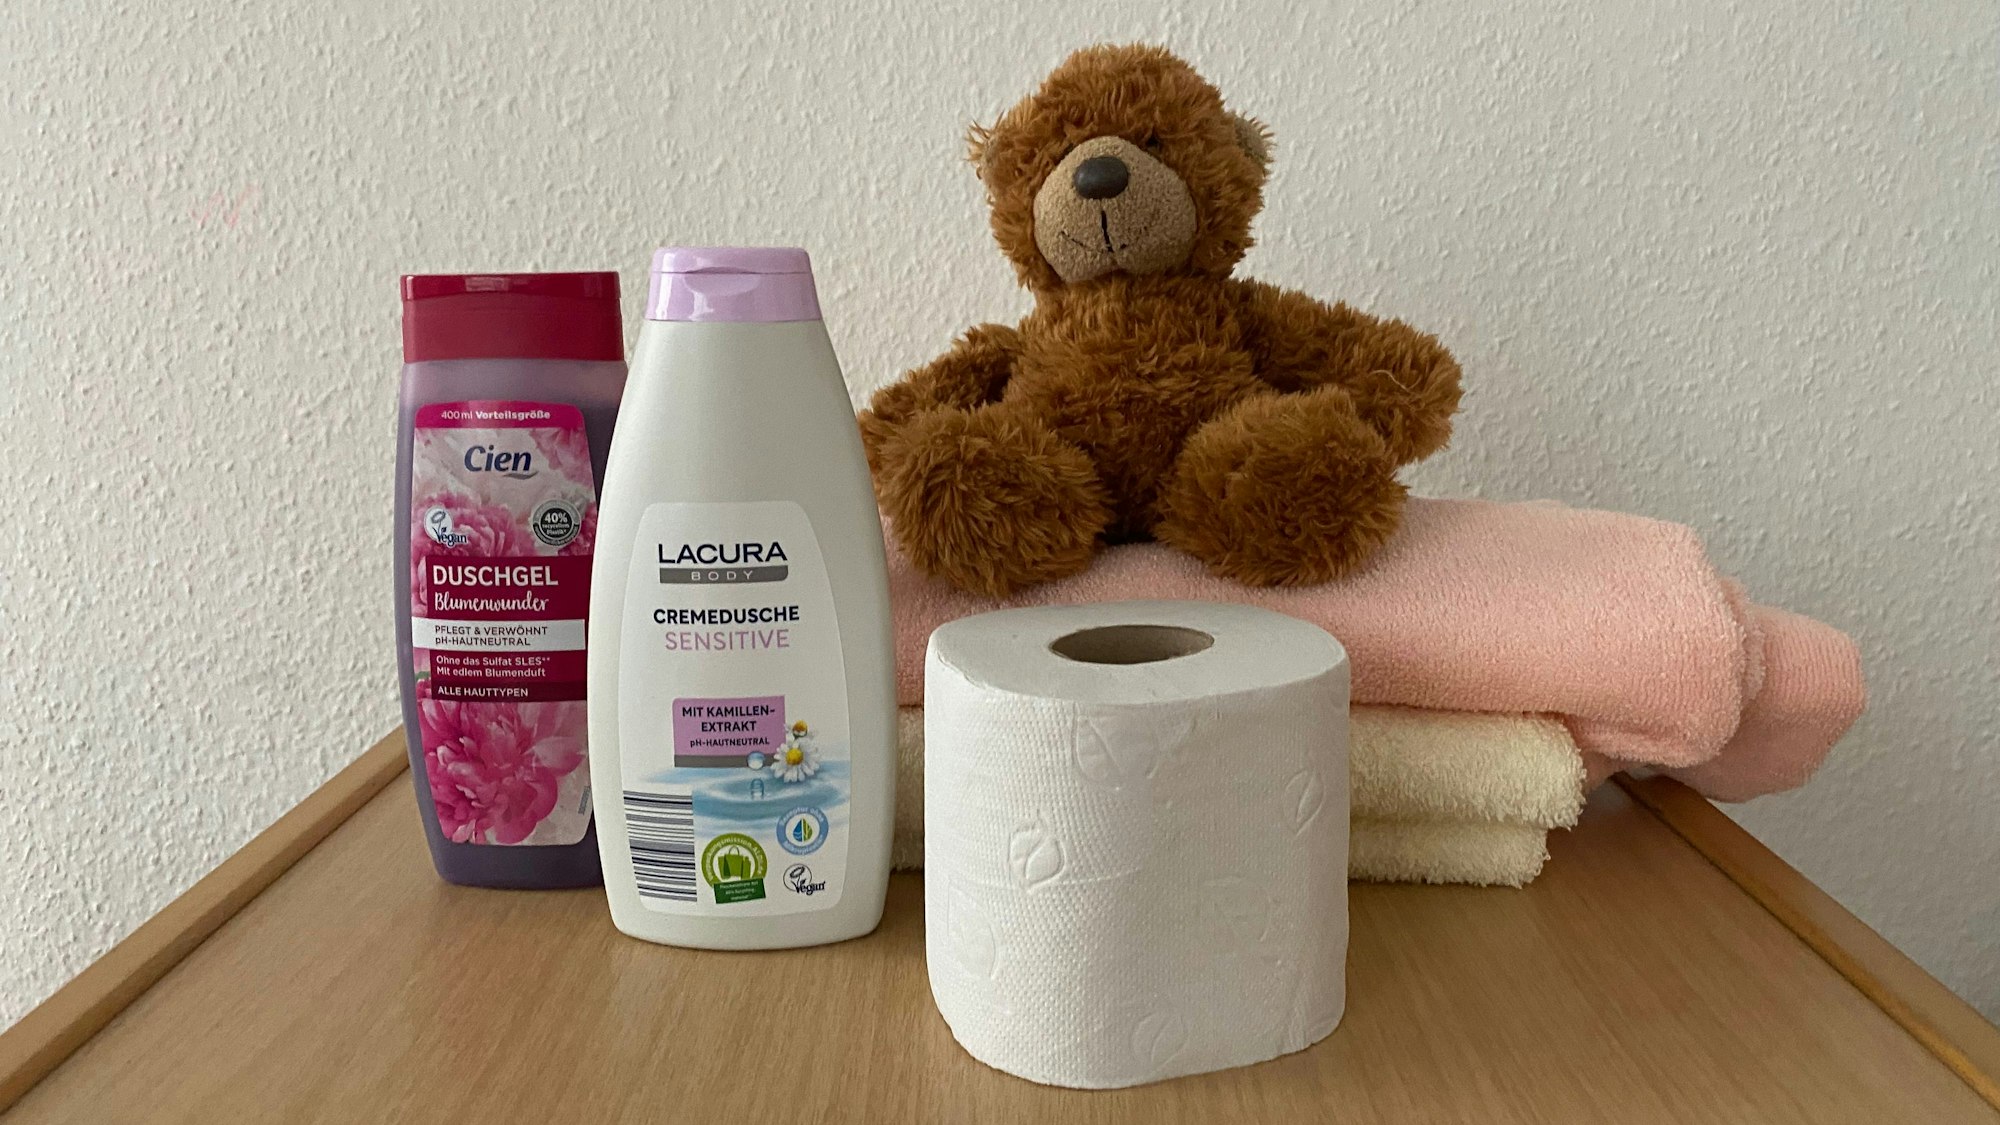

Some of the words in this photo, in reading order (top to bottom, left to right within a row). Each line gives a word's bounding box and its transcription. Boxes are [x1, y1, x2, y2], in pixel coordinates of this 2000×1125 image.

[475, 409, 551, 421] Vorteilsgröße
[464, 444, 532, 472] Cien
[544, 512, 568, 524] 40%
[432, 526, 467, 547] Vegan
[658, 541, 788, 564] LACURA
[433, 565, 559, 587] DUSCHGEL
[691, 570, 753, 581] BODY
[434, 590, 550, 612] Blumenwunder
[653, 605, 800, 625] CREMEDUSCHE
[435, 625, 471, 635] PFLEGT
[474, 626, 481, 636] &
[483, 625, 548, 636] VERWÖHNT
[435, 636, 531, 646] pH-HAUTNEUTRAL
[665, 628, 790, 651] SENSITIVE
[436, 655, 461, 666] Ohne
[463, 656, 480, 666] das
[482, 656, 512, 666] Sulfat
[436, 666, 451, 676] Mit
[453, 666, 483, 677] edlem
[485, 667, 546, 678] Blumenduft
[437, 686, 462, 696] ALLE
[463, 687, 529, 697] HAUTTYPEN
[682, 706, 704, 718] MIT
[706, 704, 776, 718] KAMILLEN-
[701, 720, 757, 733] EXTRAKT
[690, 736, 770, 748] pH-HAUTNEUTRAL
